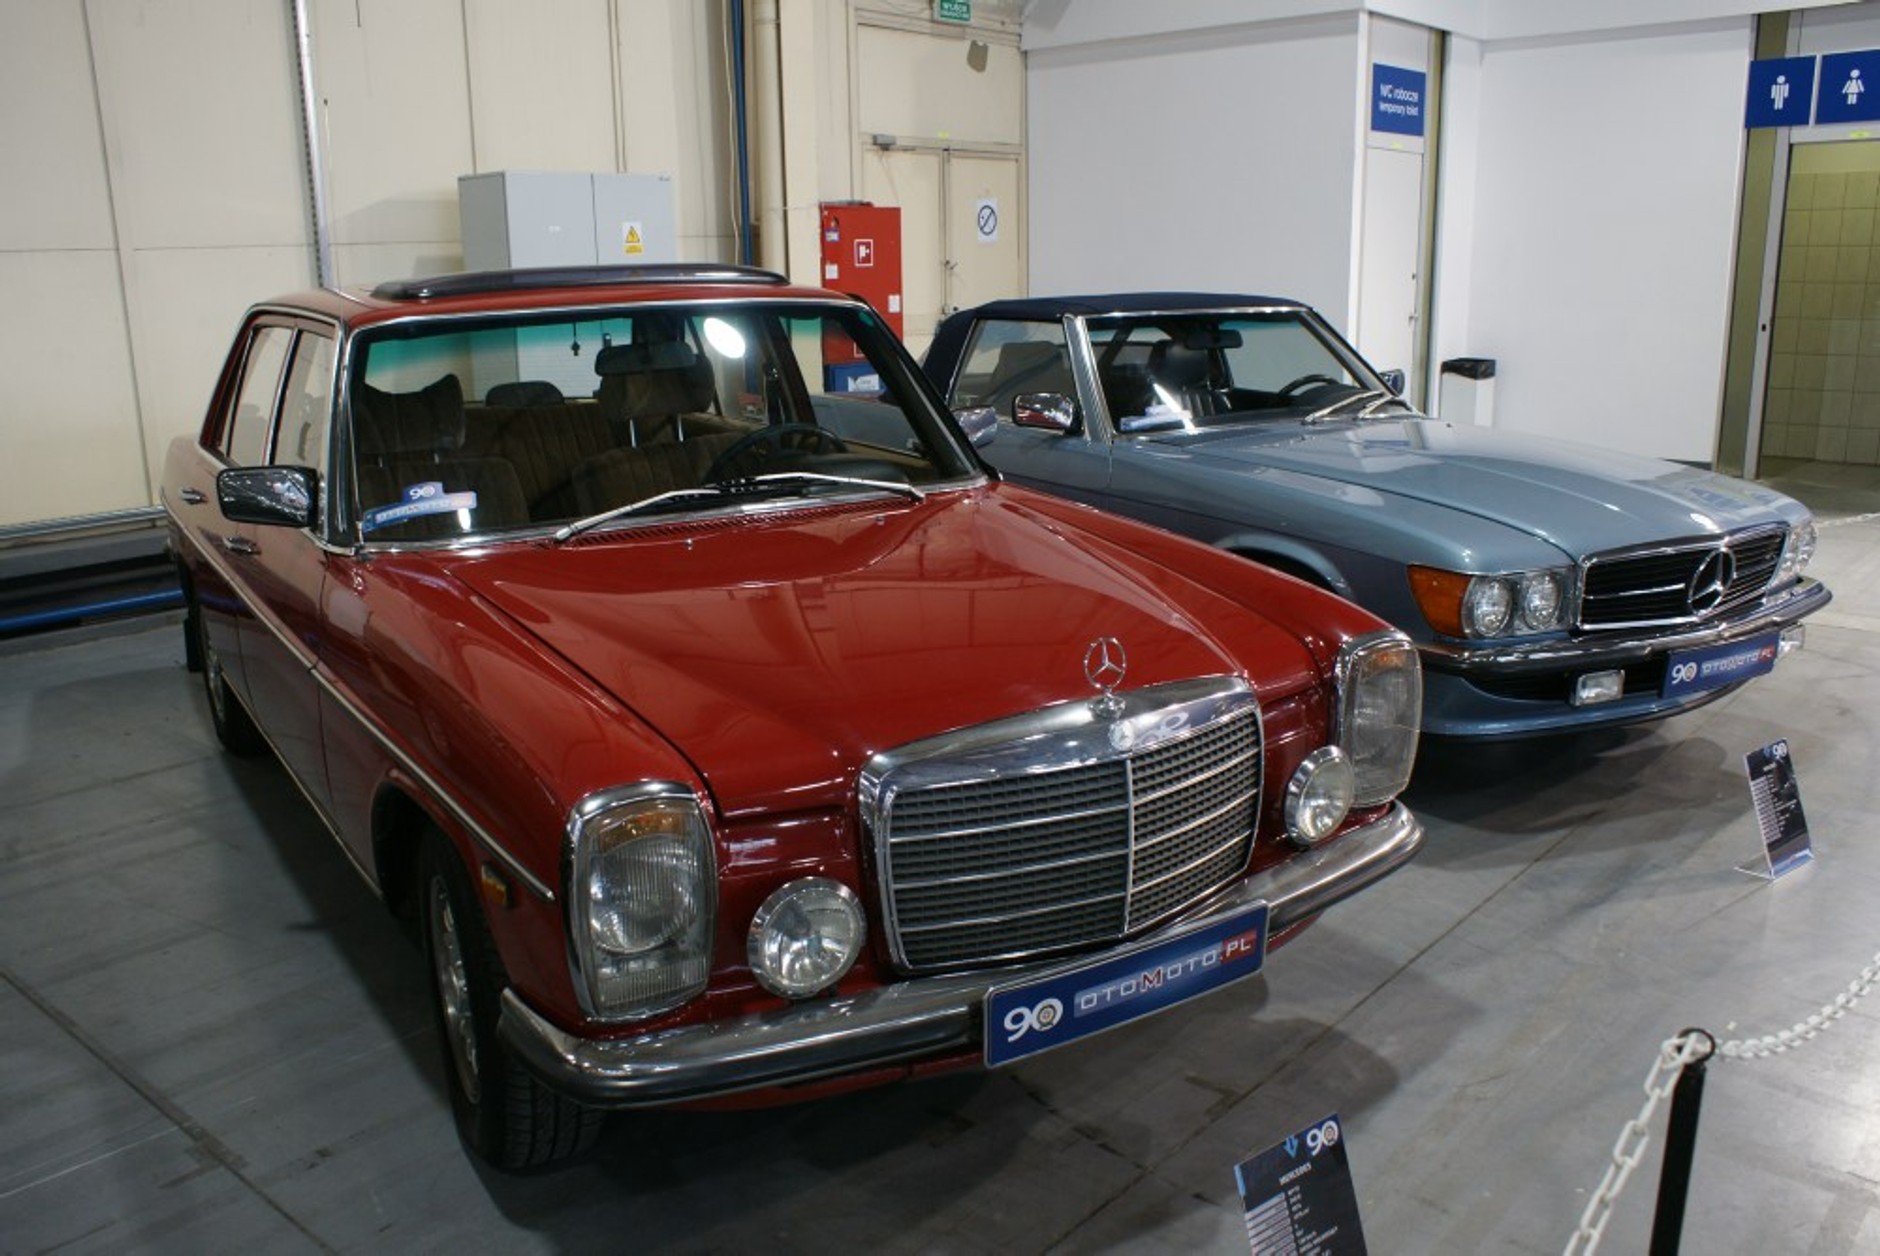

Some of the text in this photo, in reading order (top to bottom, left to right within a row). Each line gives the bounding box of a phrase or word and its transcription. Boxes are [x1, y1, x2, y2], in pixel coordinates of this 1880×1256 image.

[1672, 662, 1697, 684] 90
[1773, 742, 1788, 759] 90
[1003, 998, 1064, 1043] 90
[1306, 1120, 1339, 1156] 90
